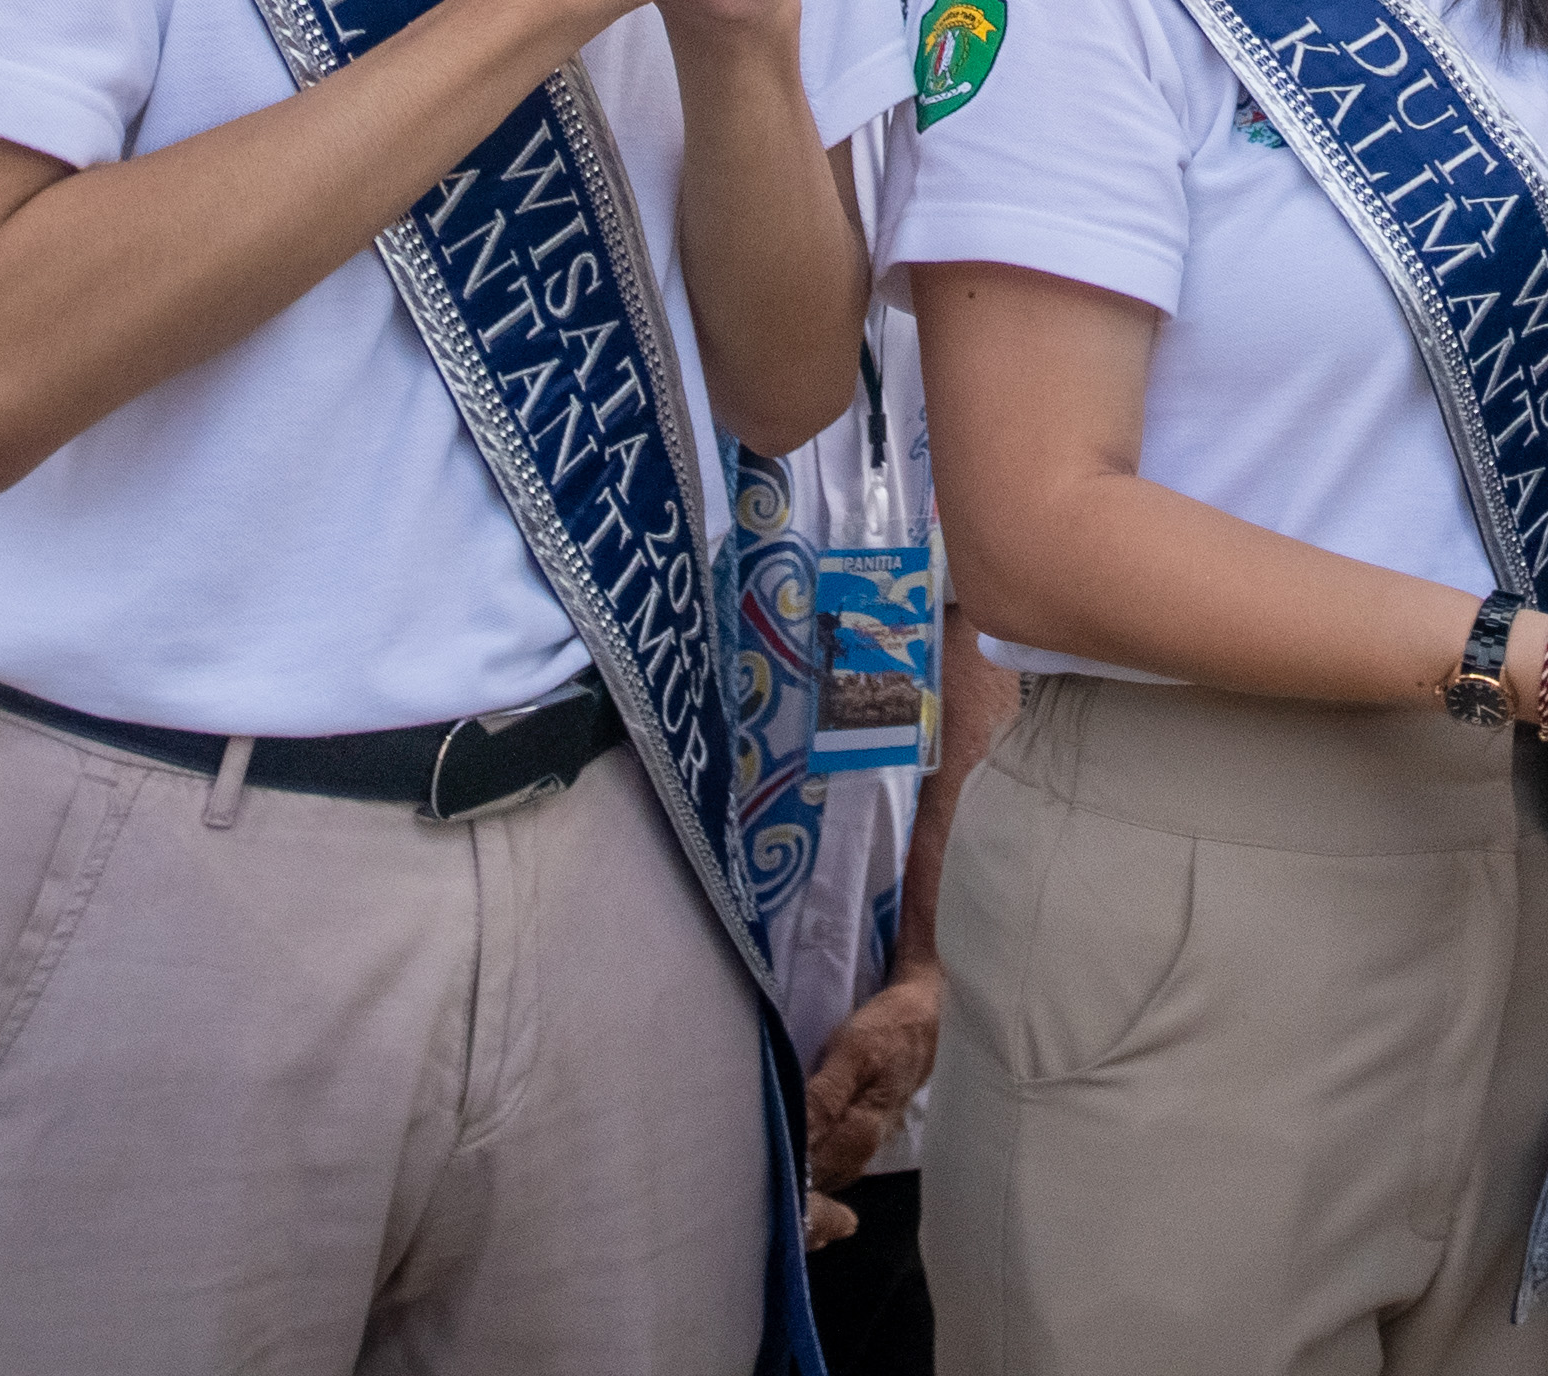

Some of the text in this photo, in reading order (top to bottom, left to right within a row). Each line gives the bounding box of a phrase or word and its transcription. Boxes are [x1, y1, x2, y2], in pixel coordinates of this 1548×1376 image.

[1341, 17, 1520, 253] DUTA
[502, 120, 648, 505] WISATA
[579, 485, 708, 806] TIMUR
